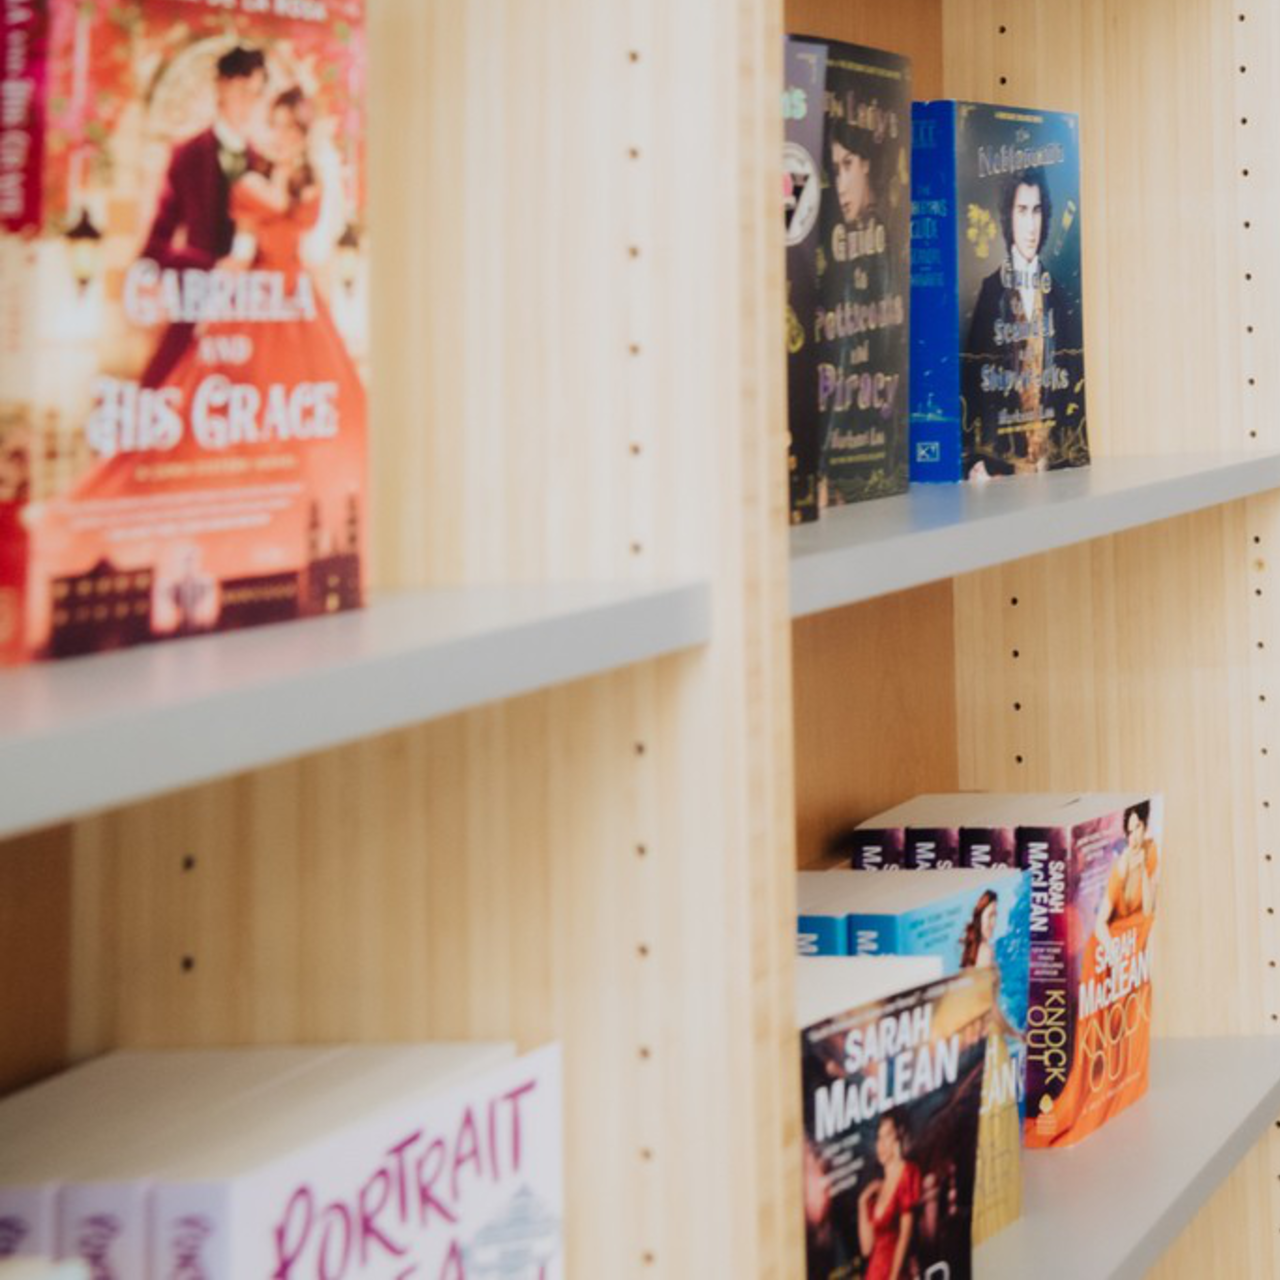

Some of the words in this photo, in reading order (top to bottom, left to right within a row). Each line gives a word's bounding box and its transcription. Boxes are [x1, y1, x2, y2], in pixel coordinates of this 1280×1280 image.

[831, 219, 885, 261] Guide
[123, 258, 318, 327] GABRIELA
[198, 333, 253, 365] AND
[86, 375, 184, 458] HIS
[191, 373, 339, 451] GRACE
[817, 362, 899, 418] Piracy
[1048, 860, 1065, 914] SARAH
[1095, 928, 1138, 974] SARAH
[843, 1002, 932, 1073] SARAH
[1026, 1005, 1048, 1062] OUT
[1045, 989, 1067, 1084] KNOCK
[1078, 985, 1150, 1057] KNOCK
[1090, 1029, 1140, 1093] OUT
